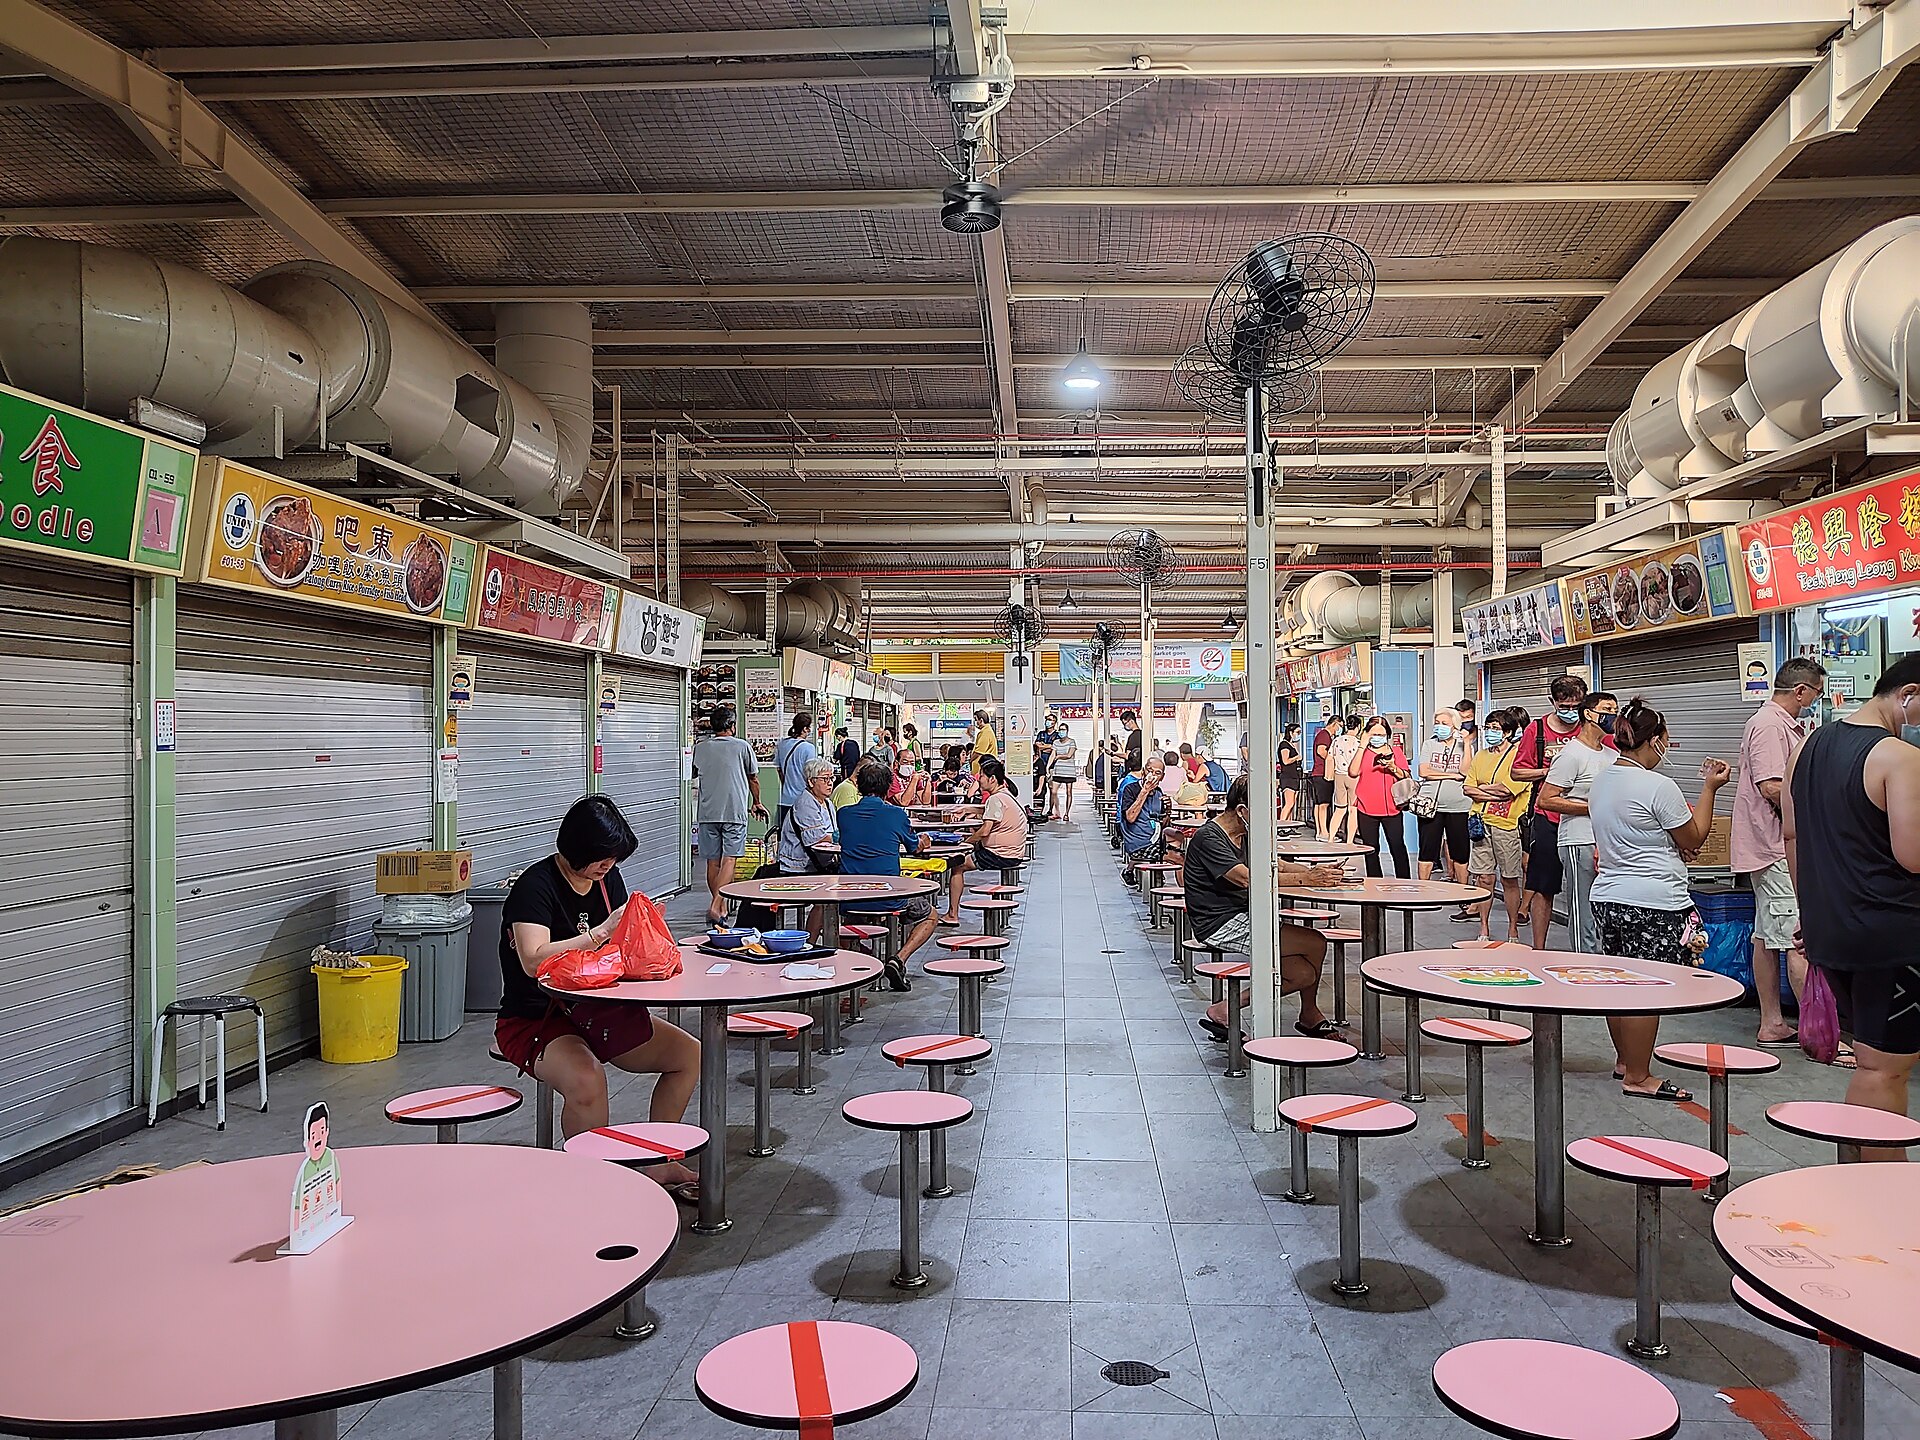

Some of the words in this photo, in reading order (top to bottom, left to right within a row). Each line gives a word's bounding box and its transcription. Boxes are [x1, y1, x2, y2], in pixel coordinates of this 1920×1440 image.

[0, 413, 81, 496] 食
[0, 500, 94, 542] odle
[225, 513, 253, 530] UNION
[334, 515, 394, 562] 吧東
[1797, 567, 1826, 591] Teck
[1825, 565, 1857, 588] Heng
[1856, 559, 1897, 580] Leong
[1155, 659, 1191, 669] FREE
